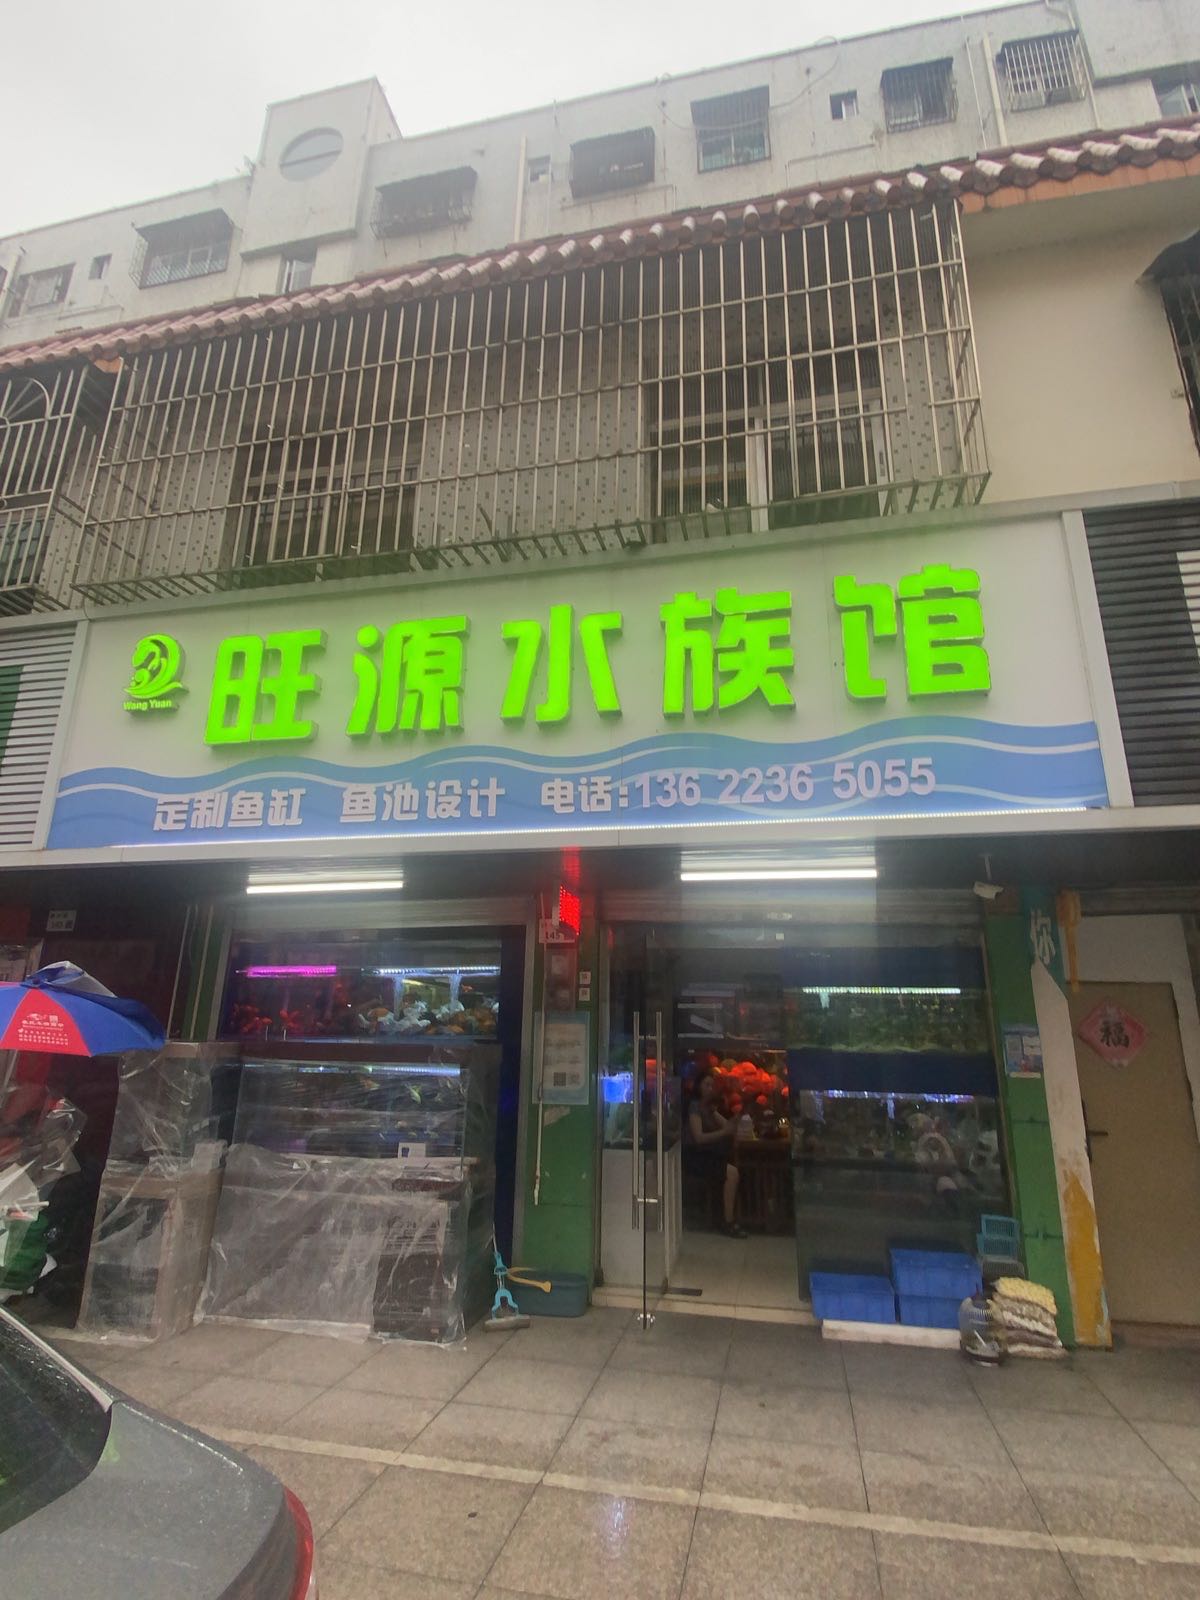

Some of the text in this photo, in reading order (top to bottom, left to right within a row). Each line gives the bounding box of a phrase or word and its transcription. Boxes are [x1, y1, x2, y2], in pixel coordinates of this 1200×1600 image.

[203, 563, 991, 745] 旺源水族馆
[123, 699, 172, 711] Wang Yuan
[153, 787, 306, 831] 定制鱼缸
[339, 777, 505, 823] 鱼池设计
[717, 764, 814, 804] 2236
[833, 757, 936, 800] 5055
[1100, 1020, 1130, 1049] 福
